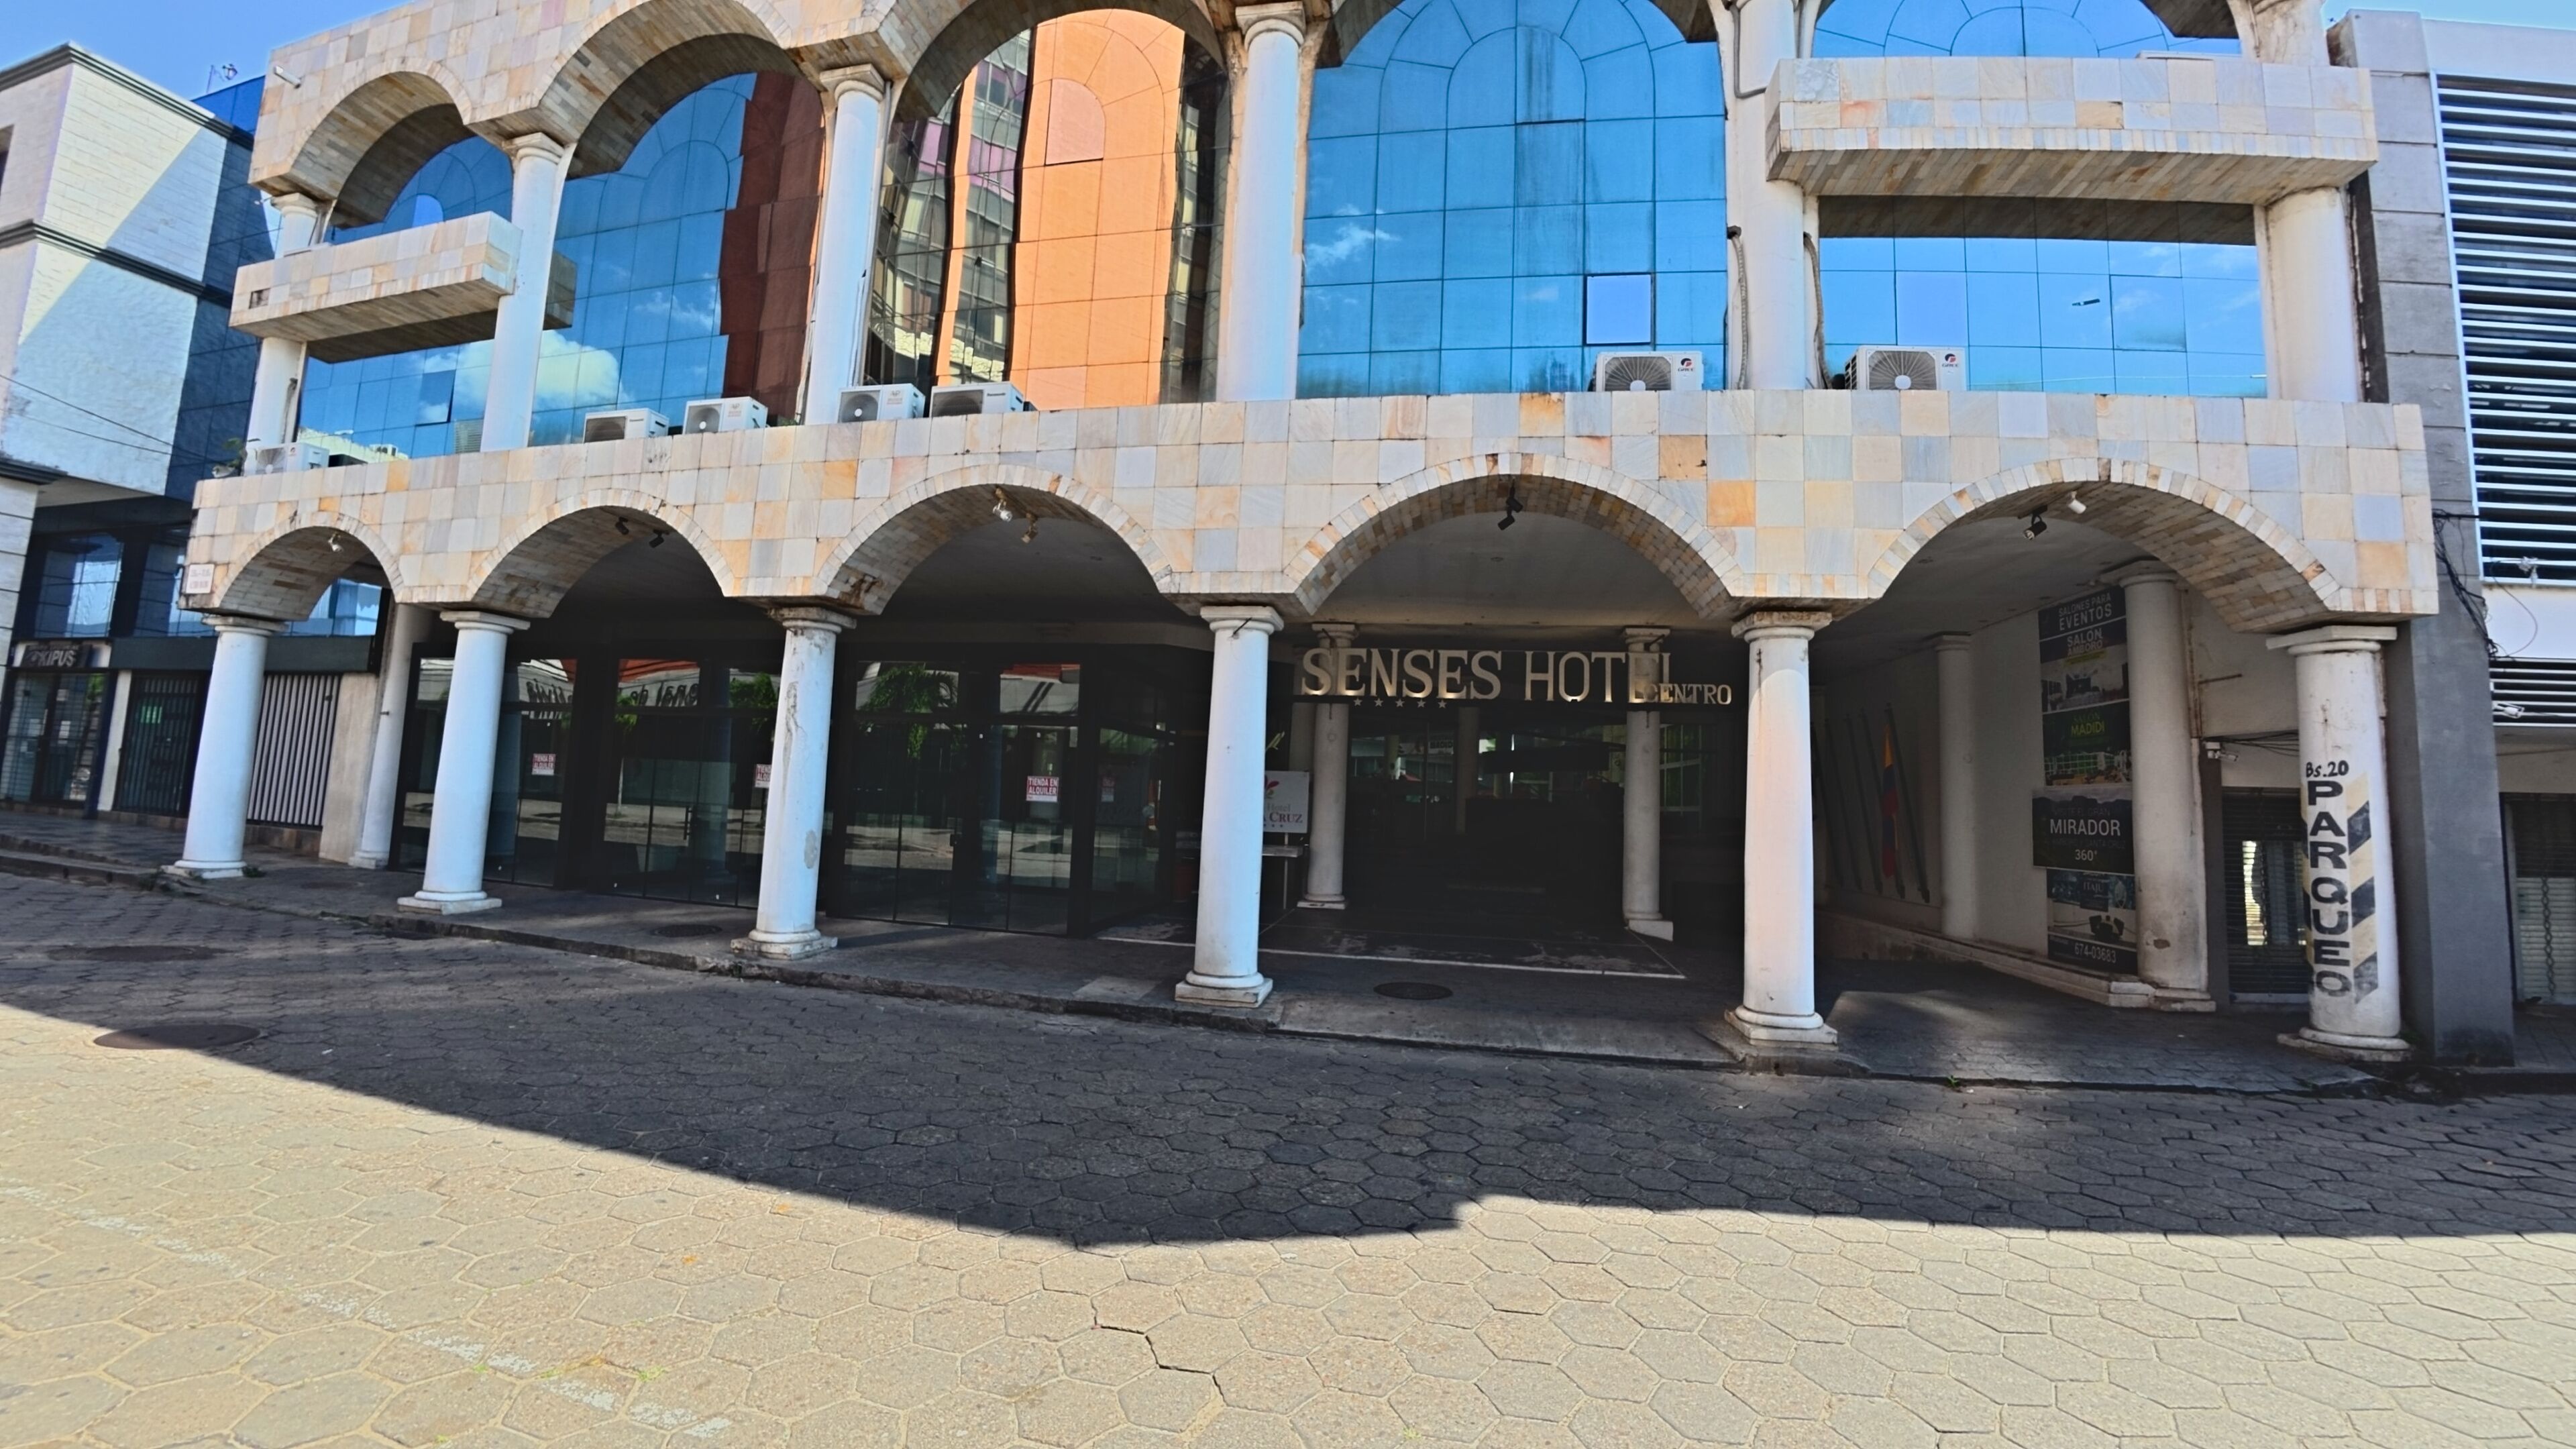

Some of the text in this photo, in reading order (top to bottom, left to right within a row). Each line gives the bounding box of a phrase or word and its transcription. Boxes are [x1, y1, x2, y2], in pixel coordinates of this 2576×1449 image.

[2059, 592, 2111, 616] SALONES PARA
[2059, 602, 2112, 631] EVENTOS
[37, 649, 77, 667] KIPUS
[1301, 647, 1671, 704] SENSES HOTEL
[1643, 683, 1732, 705] CENTRO
[2072, 720, 2105, 737] MADIDI
[2306, 759, 2349, 778] Bs.20
[1028, 777, 1058, 787] TIENDA EN
[1028, 786, 1057, 796] ALQUILER
[1267, 803, 1291, 812] Hotel
[2050, 818, 2121, 837] MIRADOR
[2308, 780, 2353, 998] PARQUEO
[2074, 942, 2116, 964] 674-03683
